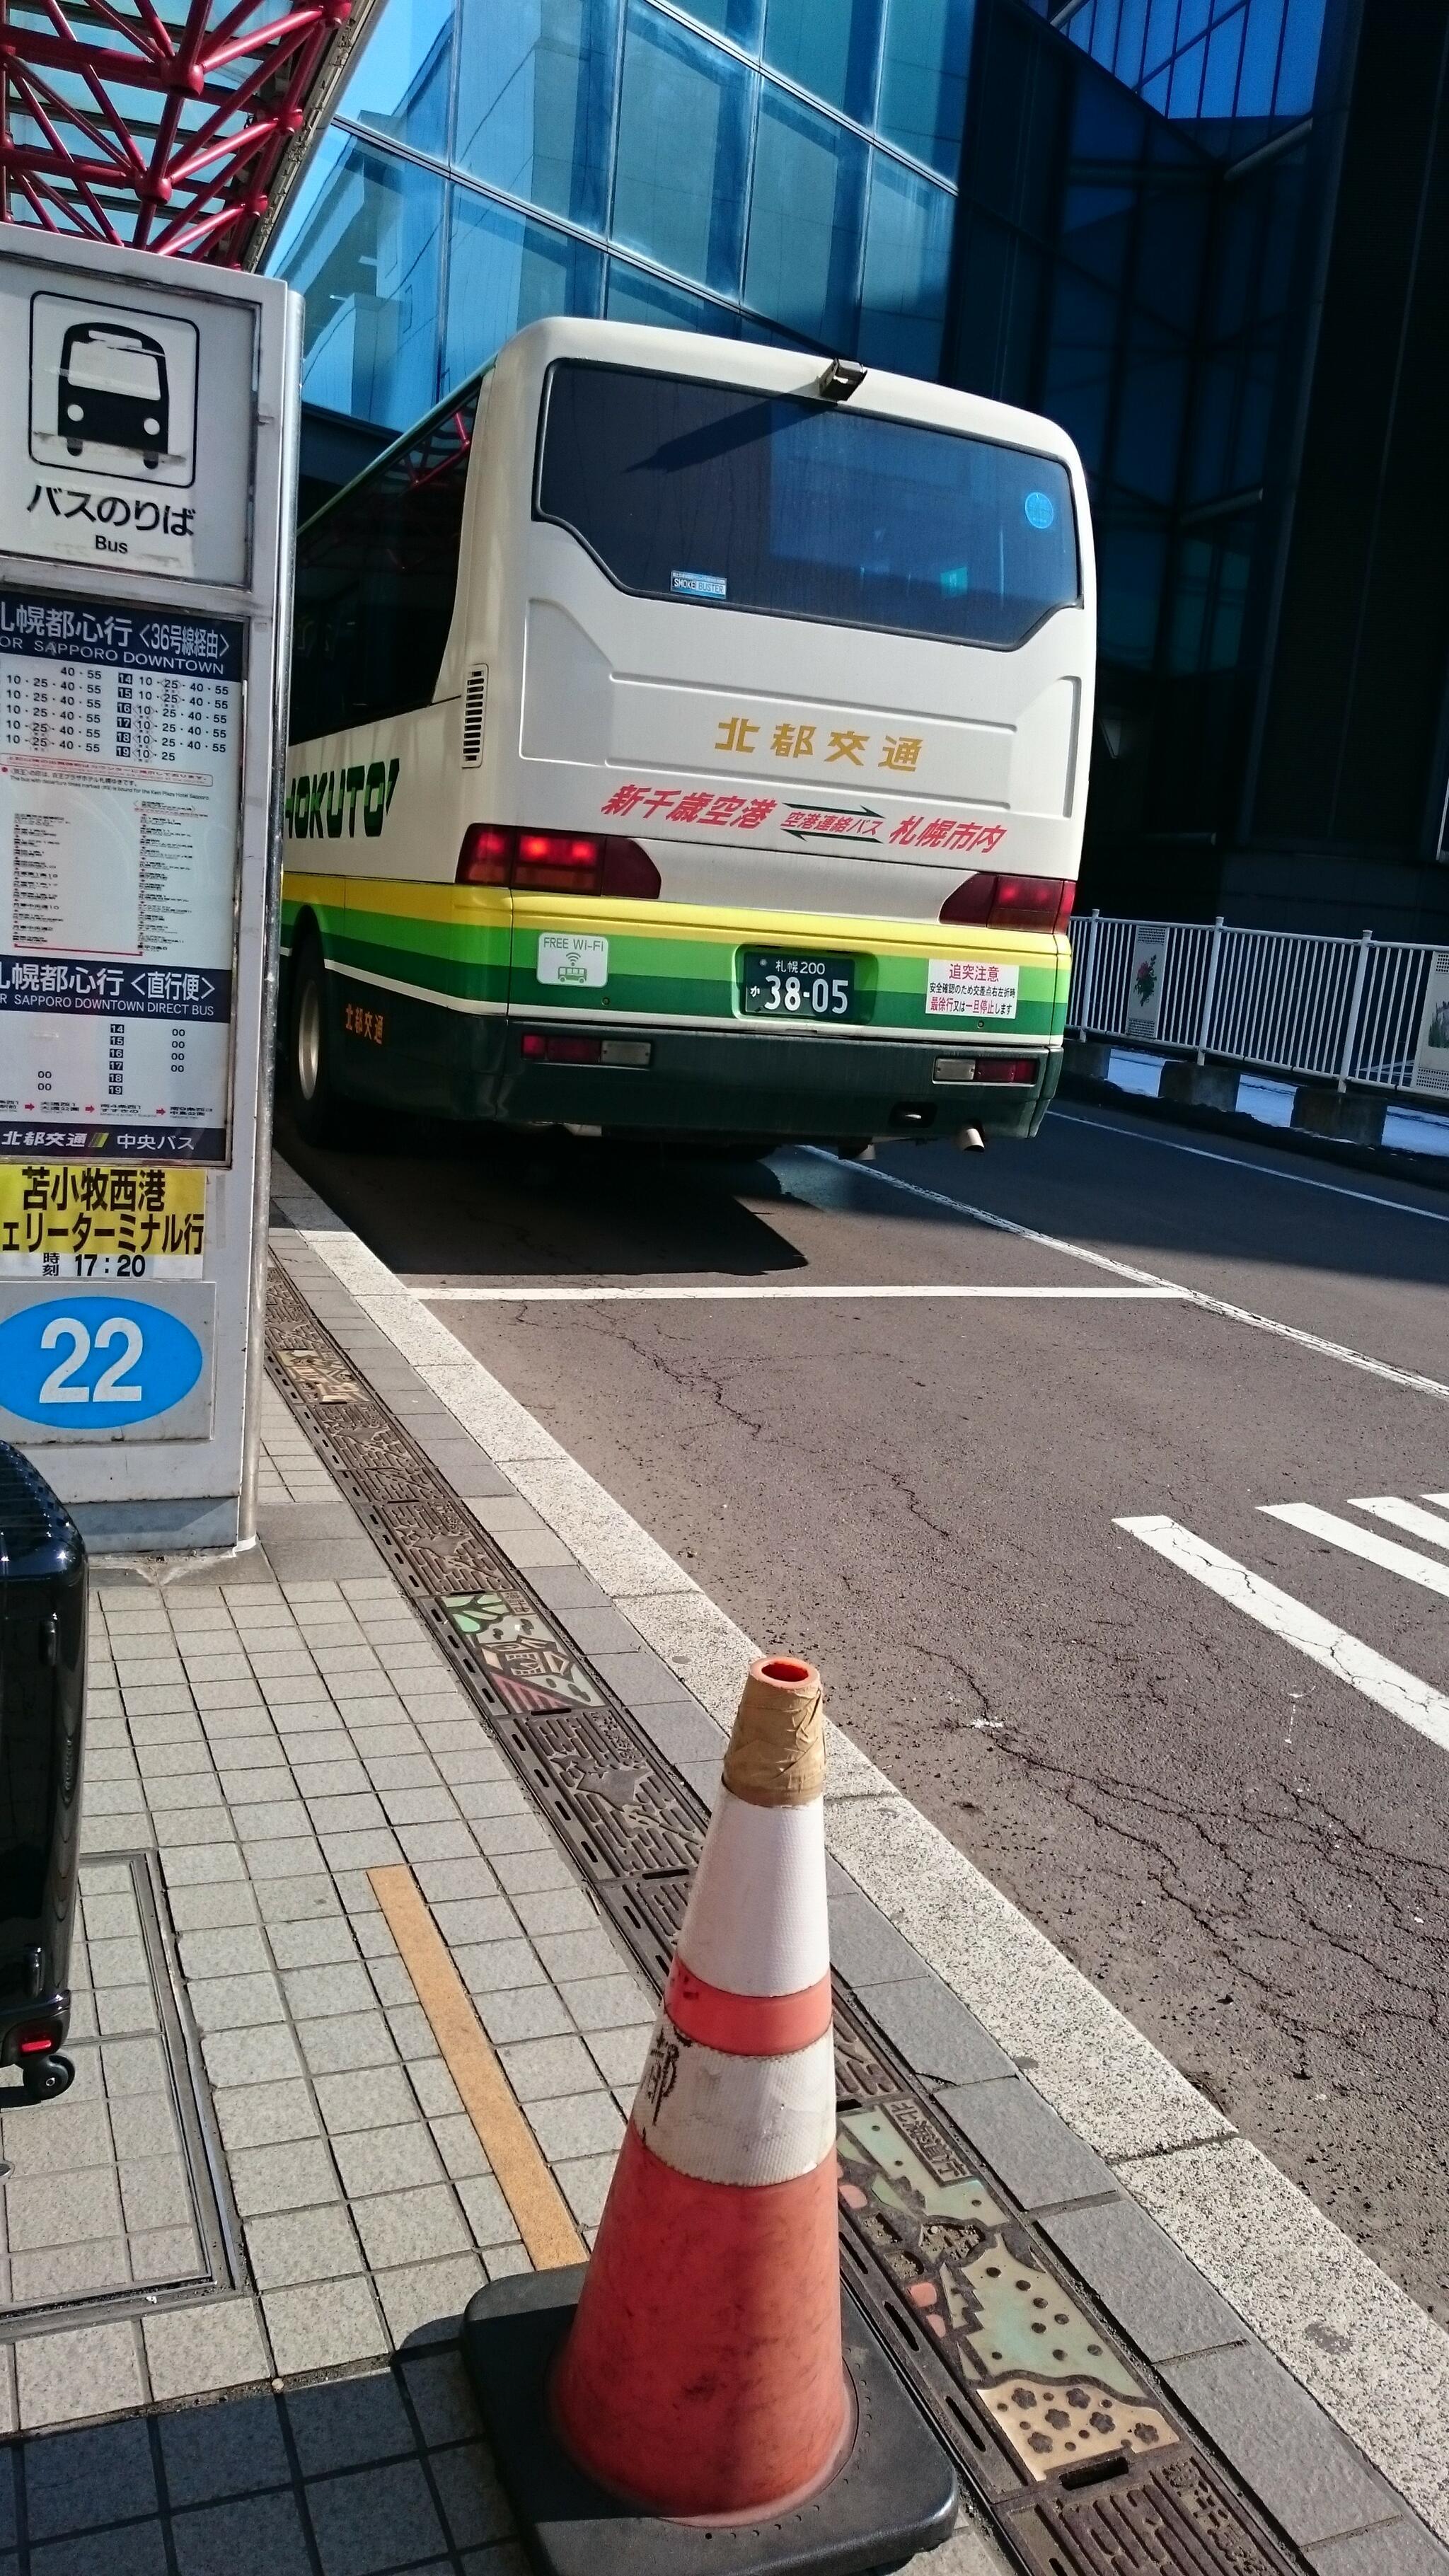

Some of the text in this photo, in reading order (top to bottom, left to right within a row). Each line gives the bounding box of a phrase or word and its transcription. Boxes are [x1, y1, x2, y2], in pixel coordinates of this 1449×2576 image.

[27, 485, 197, 537] バスのりば
[95, 535, 129, 555] Bus
[674, 579, 724, 594] SMOKE BUSTER
[34, 640, 118, 661] SAPPORO
[124, 652, 224, 674] DOWNTOWN
[715, 717, 923, 772] 北都交通
[601, 785, 1008, 853] 新千歳空港 空港連絡バス 札幌市内
[544, 937, 569, 949] FREE
[949, 964, 999, 983] 追突注意
[750, 975, 848, 1015] か 38-05
[930, 982, 1015, 998] 安全確認のため交差点右左折時
[14, 994, 71, 1007] SAPPORO
[75, 998, 144, 1012] DOWNTOWN
[147, 1003, 189, 1015] DIRECT
[192, 1005, 214, 1016] BUS
[1, 1131, 88, 1148] 北都交通
[117, 1133, 195, 1151] 中央バス
[22, 1166, 166, 1212] 苫小牧西港
[75, 1254, 146, 1278] 17:20
[39, 1317, 143, 1404] 22
